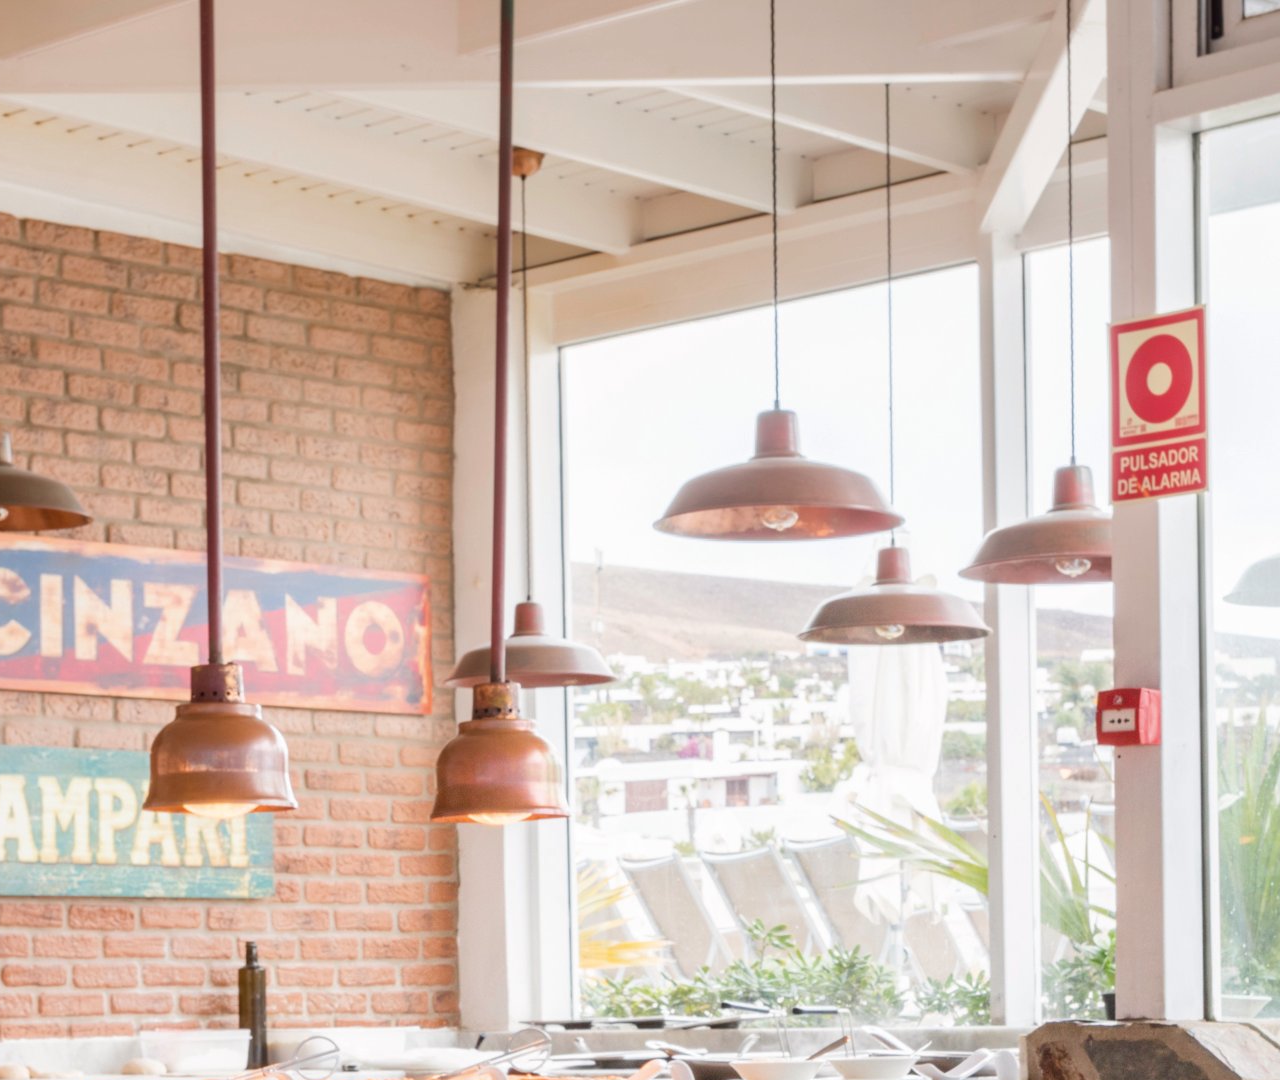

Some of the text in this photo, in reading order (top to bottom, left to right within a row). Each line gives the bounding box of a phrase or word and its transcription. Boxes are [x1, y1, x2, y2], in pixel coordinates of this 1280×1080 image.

[1120, 446, 1199, 474] PULSADOR
[1117, 468, 1201, 496] DE ALARMA
